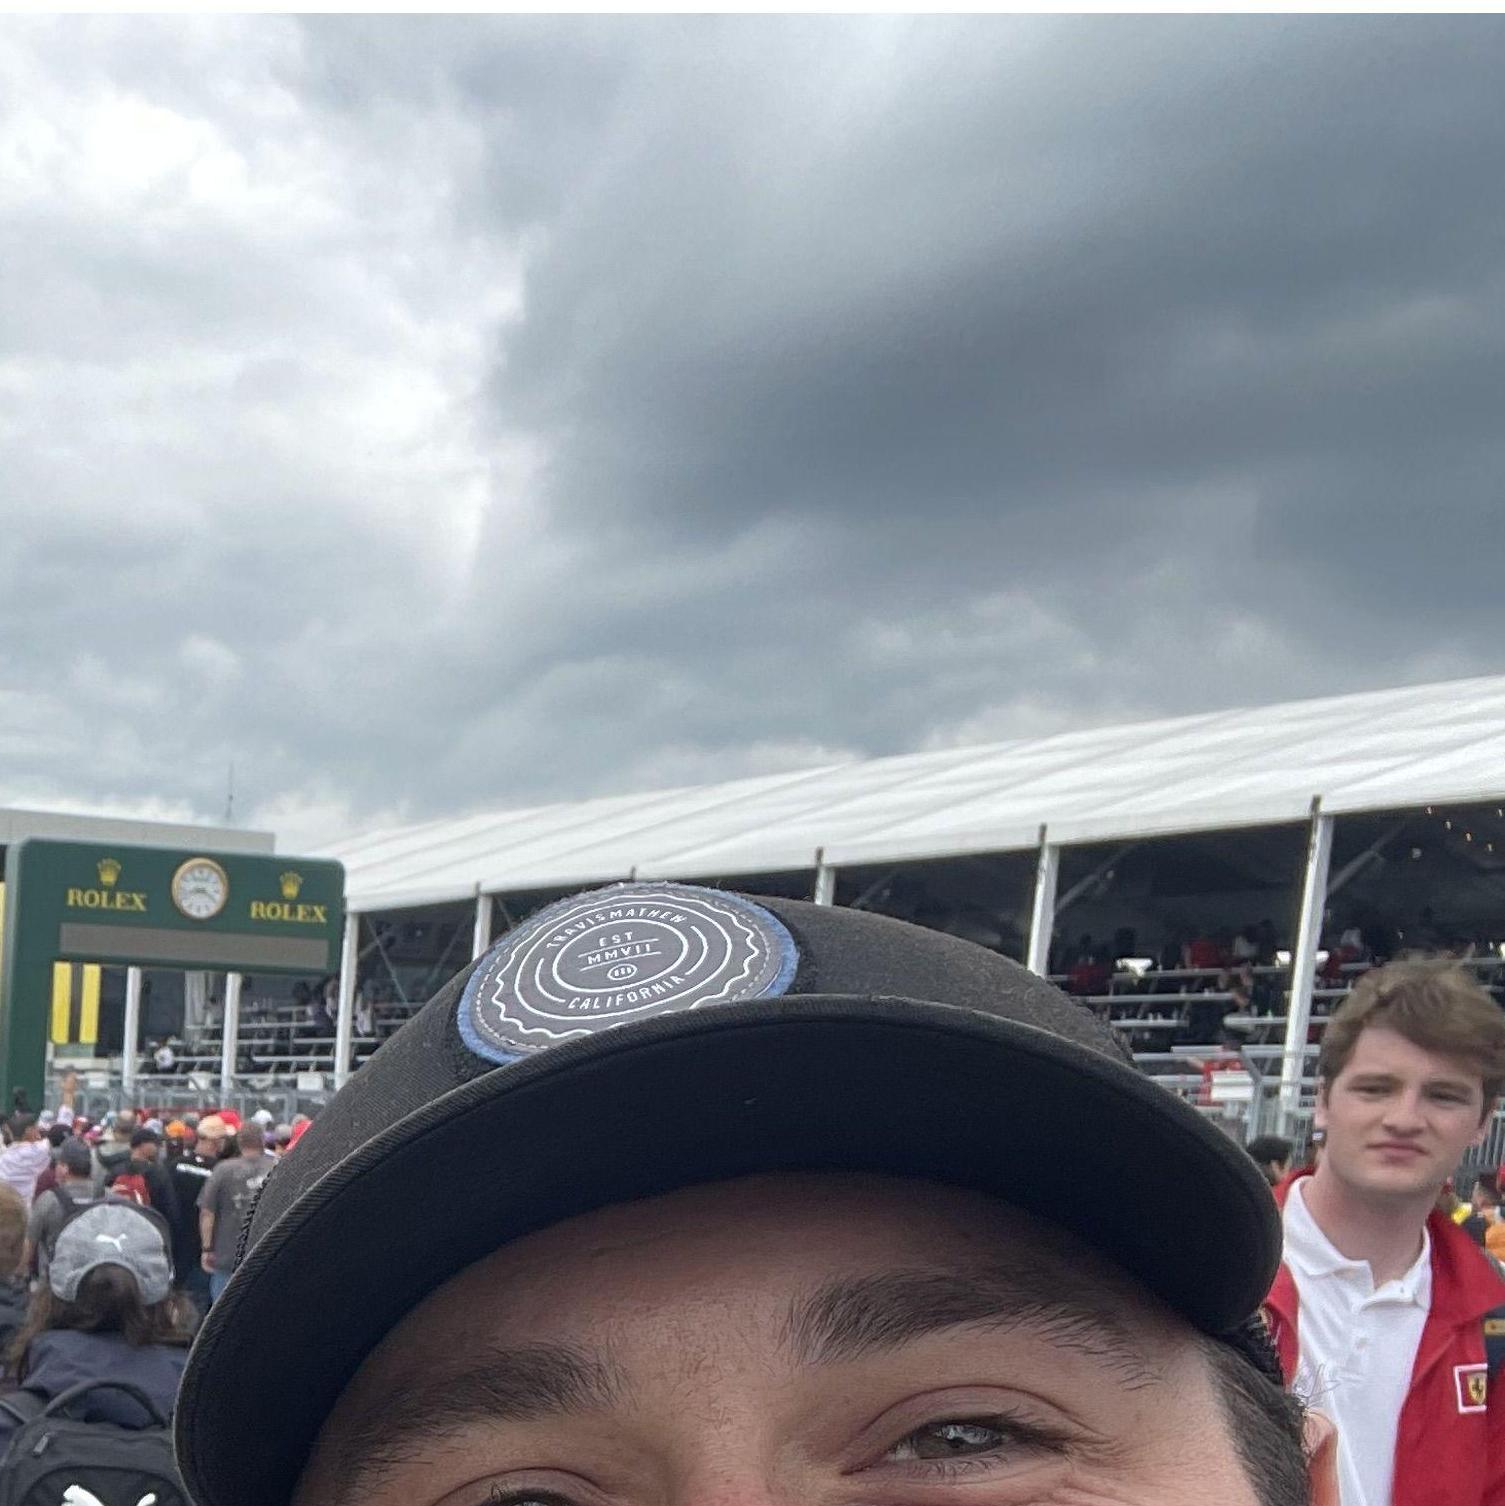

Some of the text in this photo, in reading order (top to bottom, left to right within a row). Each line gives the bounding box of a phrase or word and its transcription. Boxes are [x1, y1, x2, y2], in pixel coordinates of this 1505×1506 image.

[67, 887, 147, 912] ROLEX
[250, 900, 328, 924] ROLEX
[546, 907, 688, 949] TRAVISMATHEW
[599, 931, 634, 947] EST
[587, 943, 652, 965] MMVII
[567, 973, 686, 1010] CALIFORNIA
